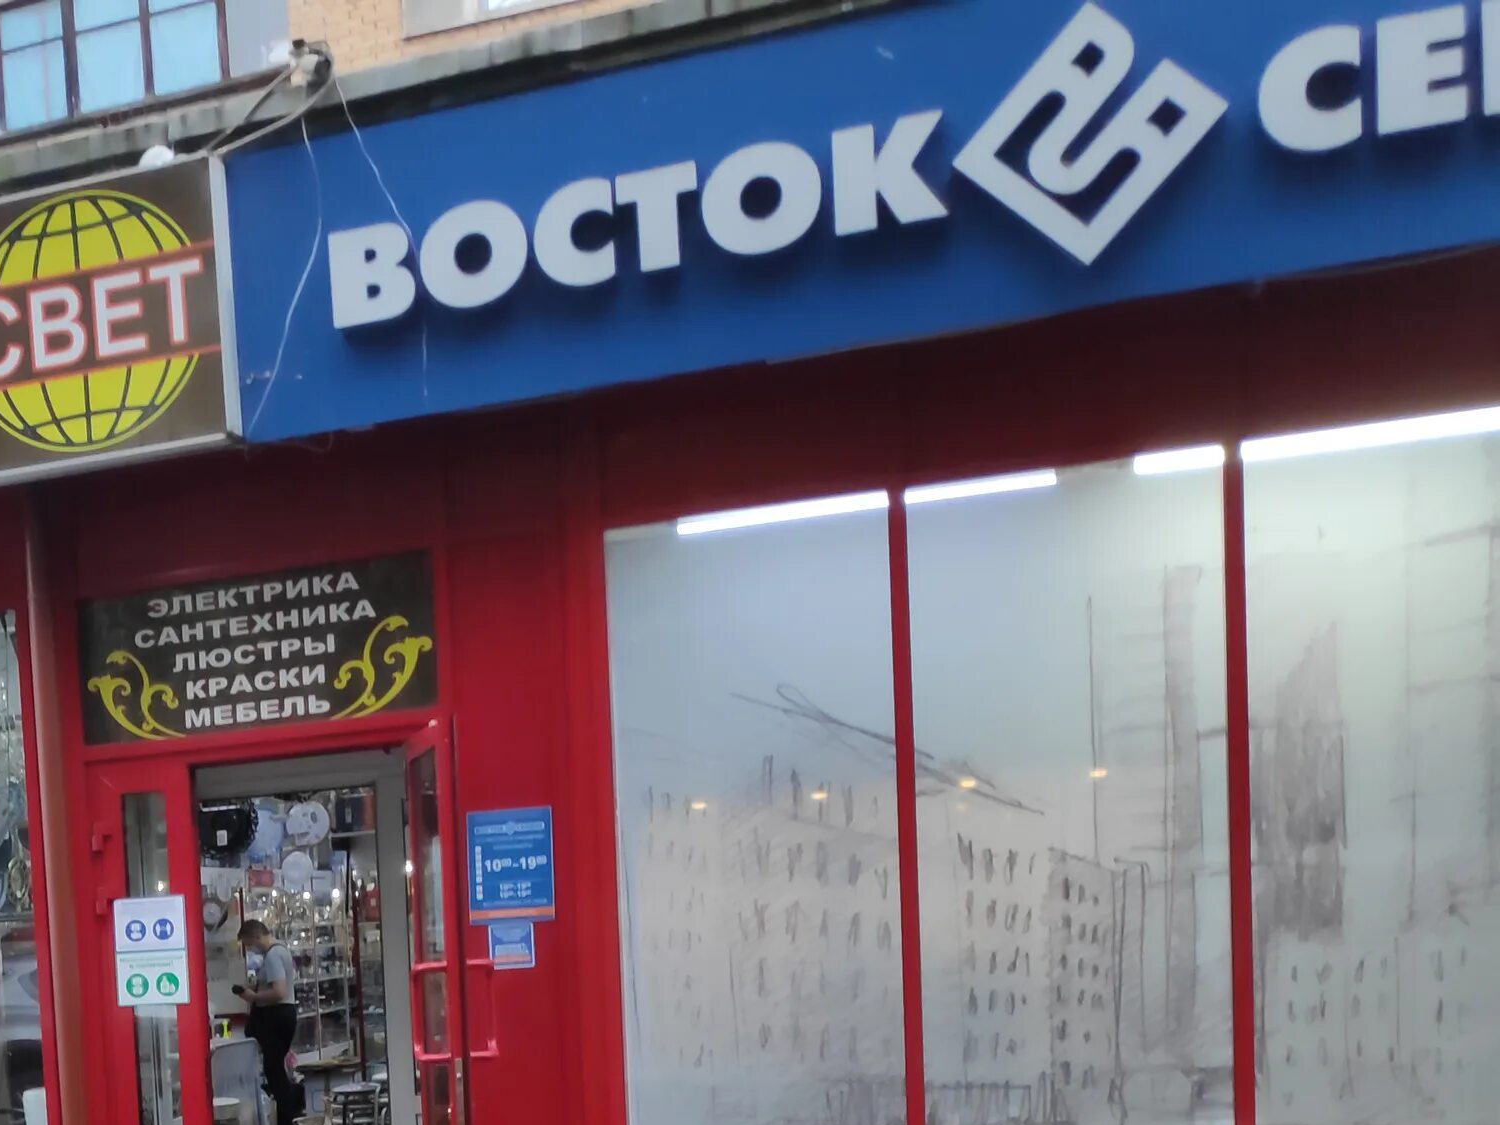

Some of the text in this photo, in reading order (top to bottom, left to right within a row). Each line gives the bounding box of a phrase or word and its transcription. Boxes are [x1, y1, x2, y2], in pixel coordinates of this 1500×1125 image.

[327, 0, 1500, 330] ВОСТОК СЕ
[147, 571, 360, 618] ЭЛЕКТРИКА
[134, 599, 376, 649] САНТЕХНИКА
[172, 633, 336, 673] ЛЮСТРЫ
[185, 664, 327, 700] КРАСКИ
[184, 694, 331, 729] МЕБЕЛЬ
